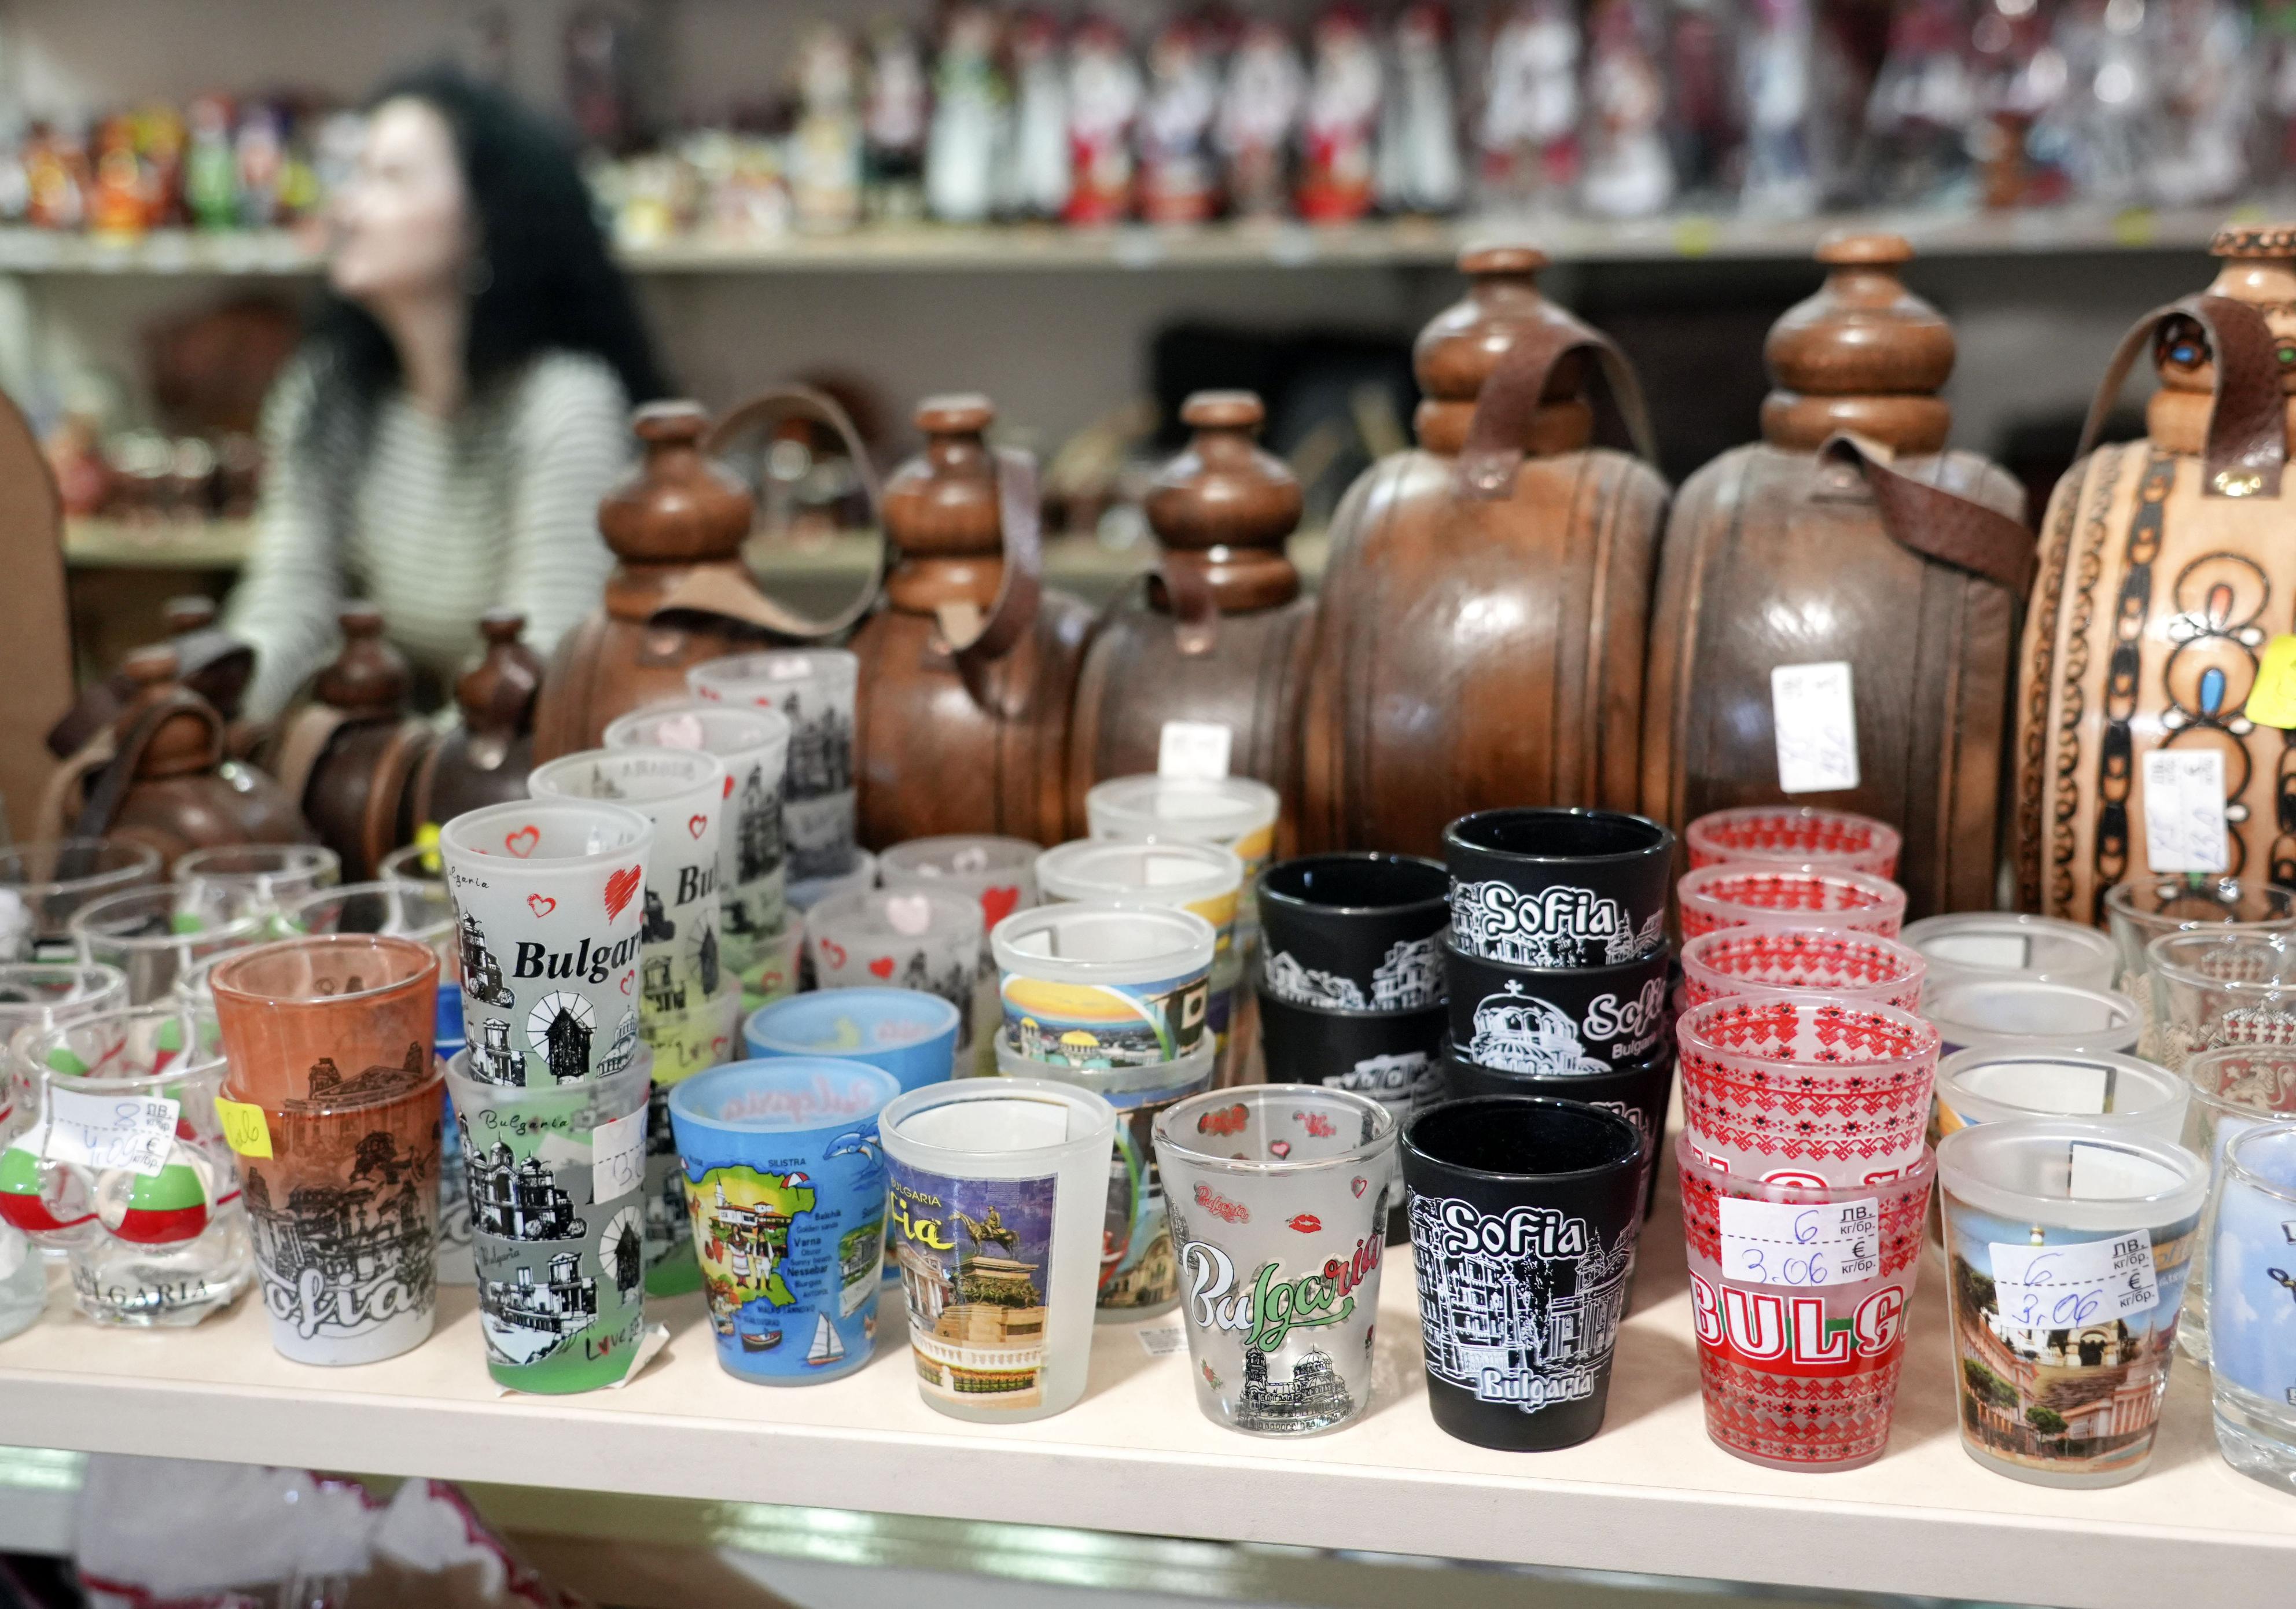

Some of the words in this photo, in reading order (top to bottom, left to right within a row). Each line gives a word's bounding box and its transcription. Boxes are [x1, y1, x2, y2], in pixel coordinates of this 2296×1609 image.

[450, 866, 490, 888] lgaria
[1480, 880, 1620, 940] Sofia
[512, 929, 641, 984] Bulgar
[1583, 977, 1666, 1041] Sofi
[114, 1103, 141, 1128] 8
[479, 1109, 569, 1136] Bulgaria
[146, 1137, 160, 1153] €
[768, 1158, 806, 1168] SILISTRA
[891, 1178, 942, 1208] BULGARIA
[1441, 1199, 1587, 1260] Sofia
[1794, 1209, 1819, 1242] 6
[1840, 1220, 1876, 1235] кг/бр.
[793, 1237, 822, 1247] Varna
[1852, 1240, 1866, 1258] €
[1842, 1259, 1876, 1275] кг/бр.
[2024, 1253, 2065, 1288] 6
[2113, 1253, 2150, 1270] кг/бр.
[1183, 1234, 1383, 1352] Bulgaria
[2128, 1272, 2142, 1290] €
[262, 1261, 418, 1339] ofia
[2120, 1290, 2155, 1308] кг/бр.
[1690, 1269, 1909, 1364] BULG
[1477, 1365, 1594, 1413] Bulgaria
